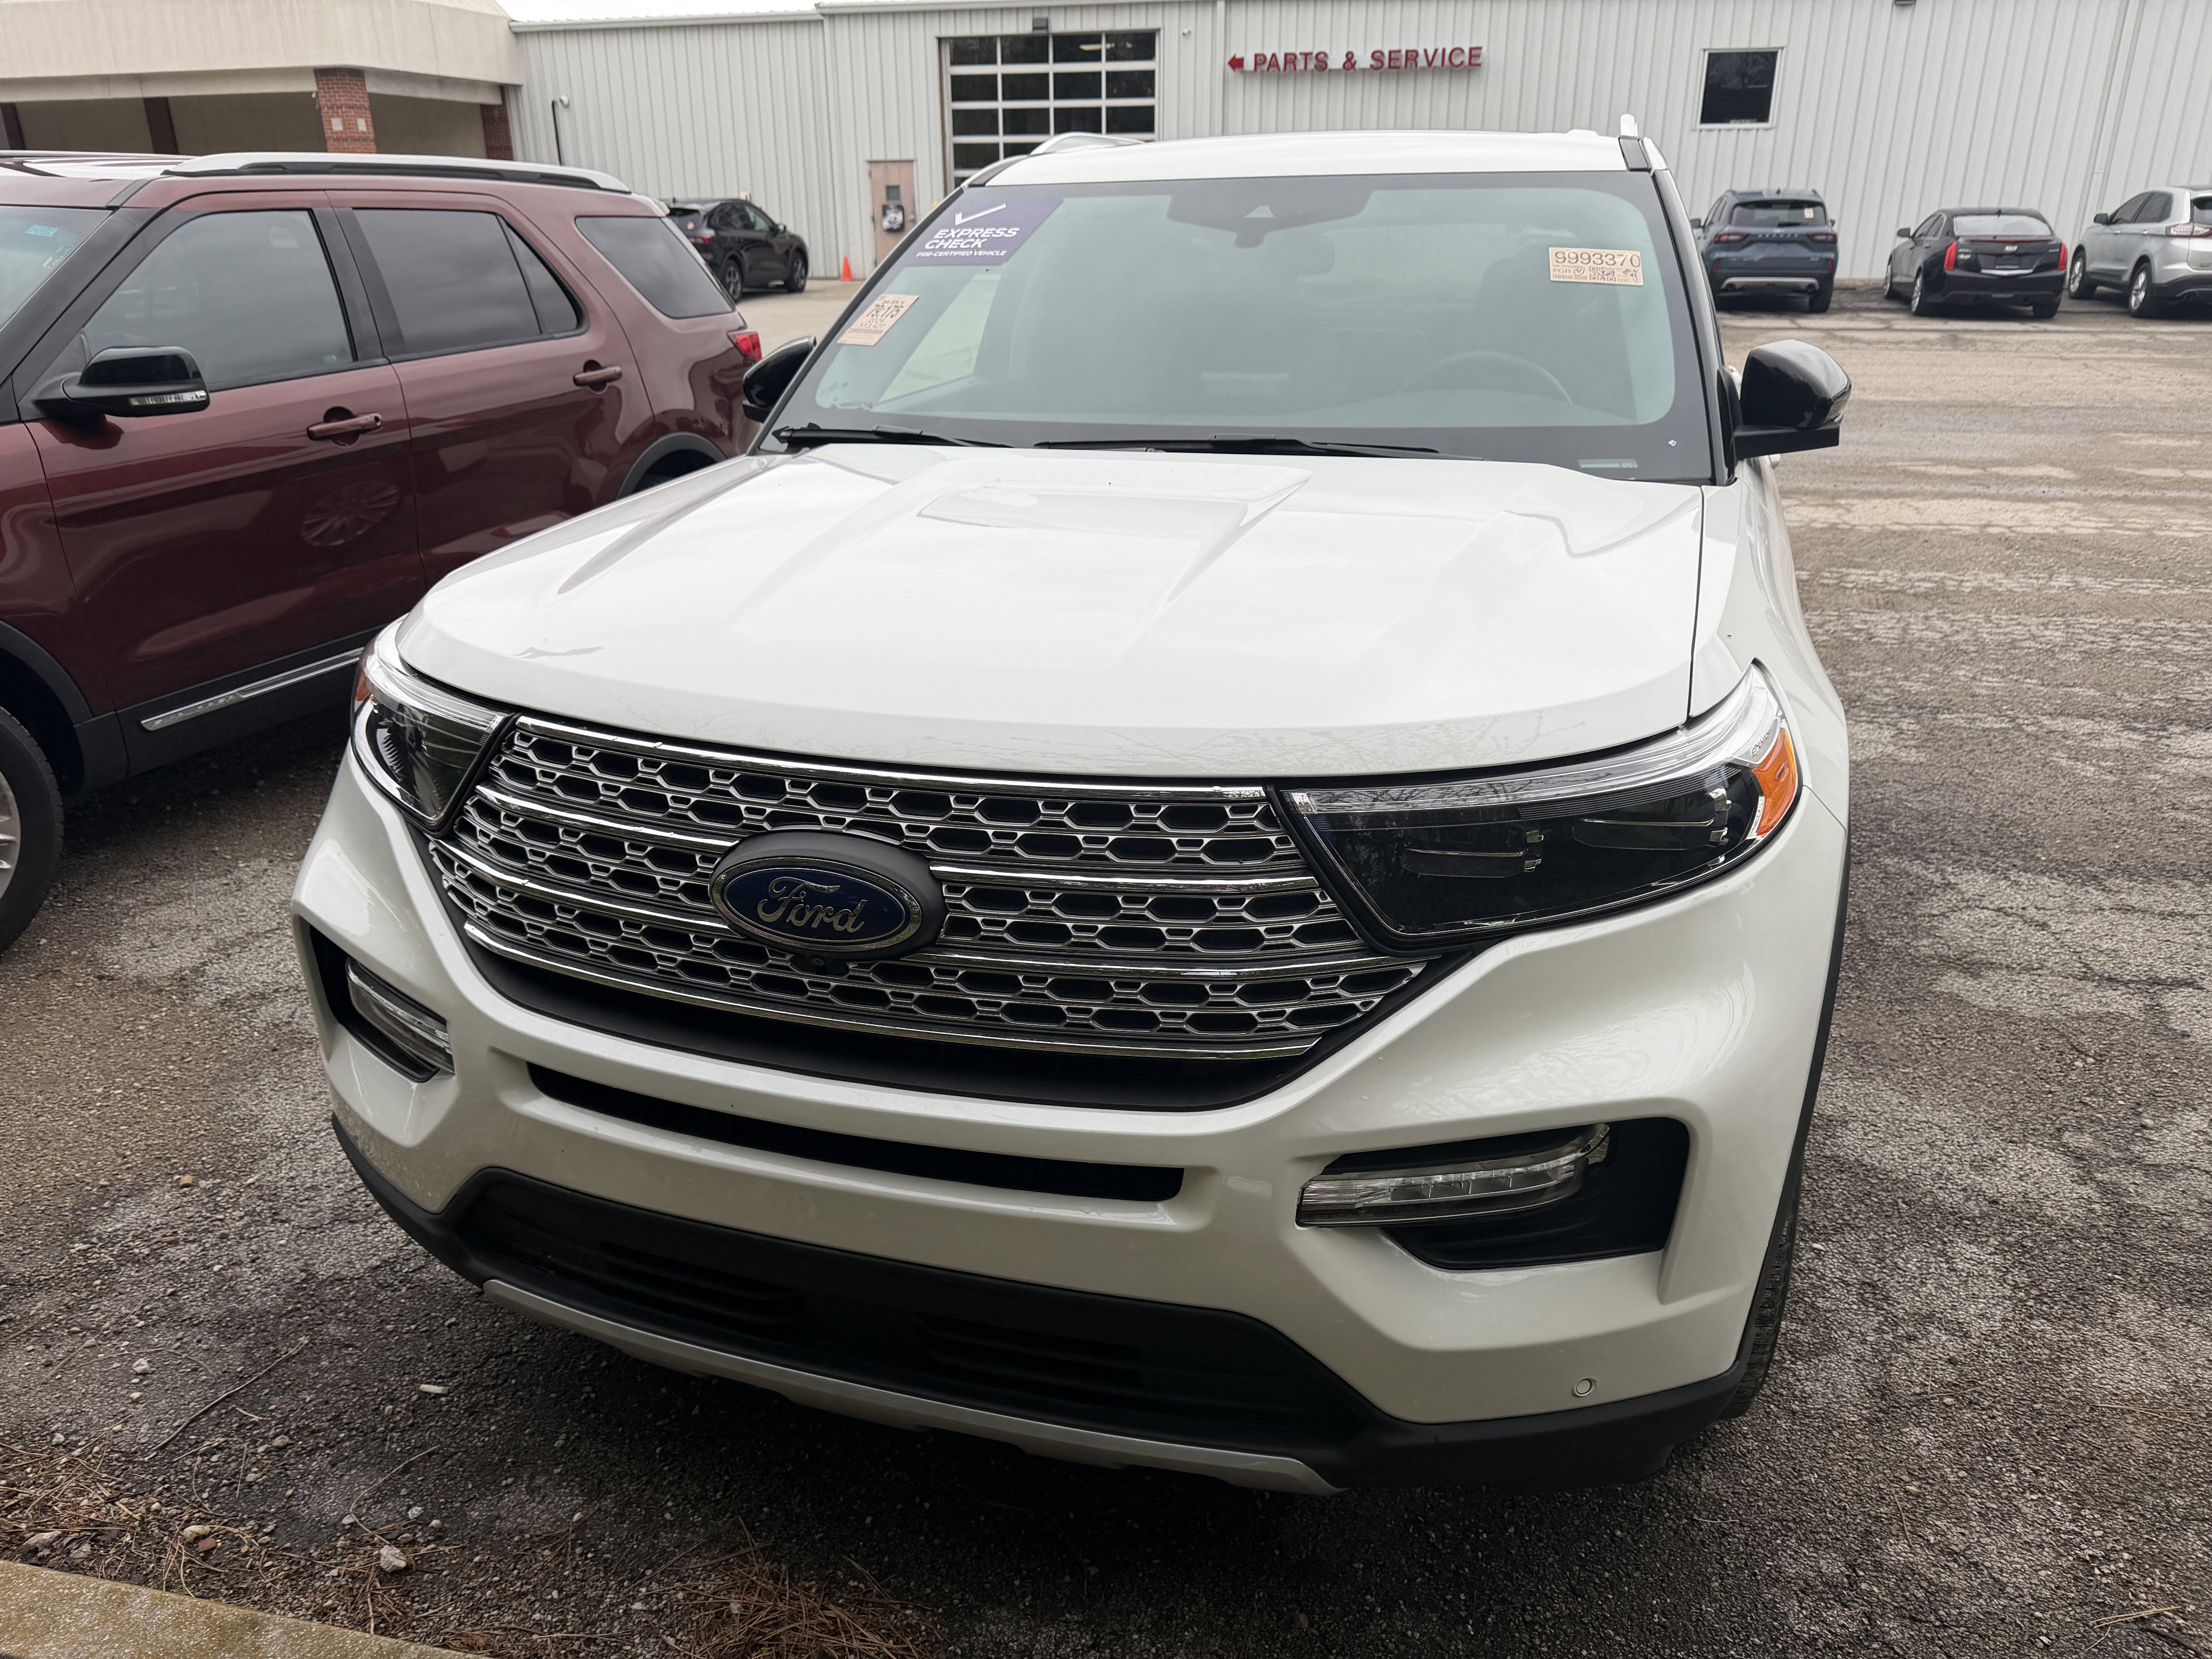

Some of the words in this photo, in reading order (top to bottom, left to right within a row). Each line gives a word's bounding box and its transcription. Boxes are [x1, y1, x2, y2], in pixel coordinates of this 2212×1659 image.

[1253, 52, 1329, 72] PARTS
[1342, 51, 1357, 71] &
[1370, 46, 1484, 70] SERVICE
[934, 227, 1020, 239] EXPRESS
[924, 239, 988, 249] CHECK
[1554, 251, 1641, 267] 9993370
[757, 876, 868, 933] Ford
